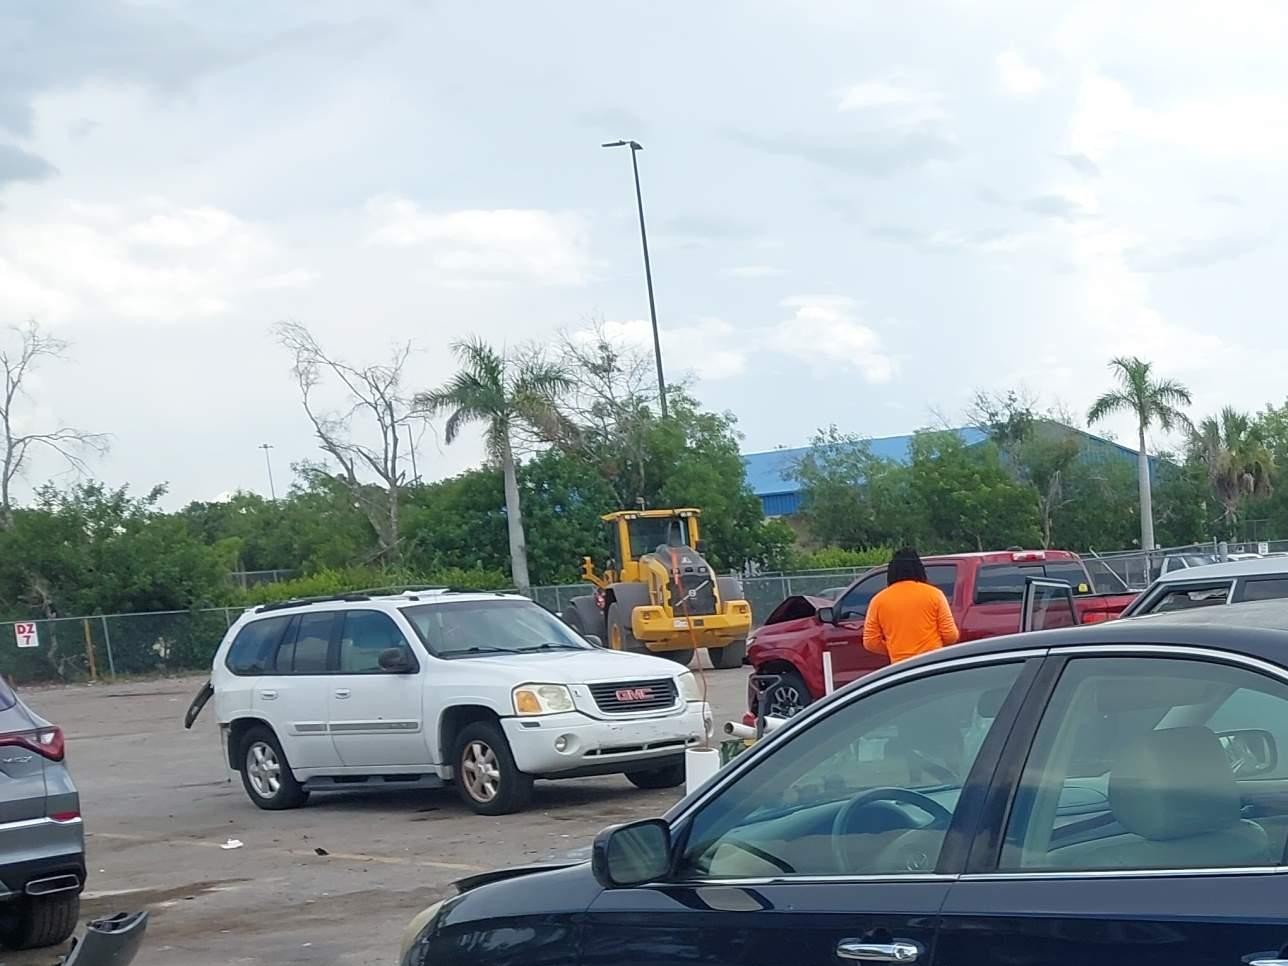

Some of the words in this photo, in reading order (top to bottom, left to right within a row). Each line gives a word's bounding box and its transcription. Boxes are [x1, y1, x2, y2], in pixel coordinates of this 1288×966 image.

[17, 624, 35, 634] DZ
[23, 635, 31, 645] 7
[615, 687, 655, 702] GMC
